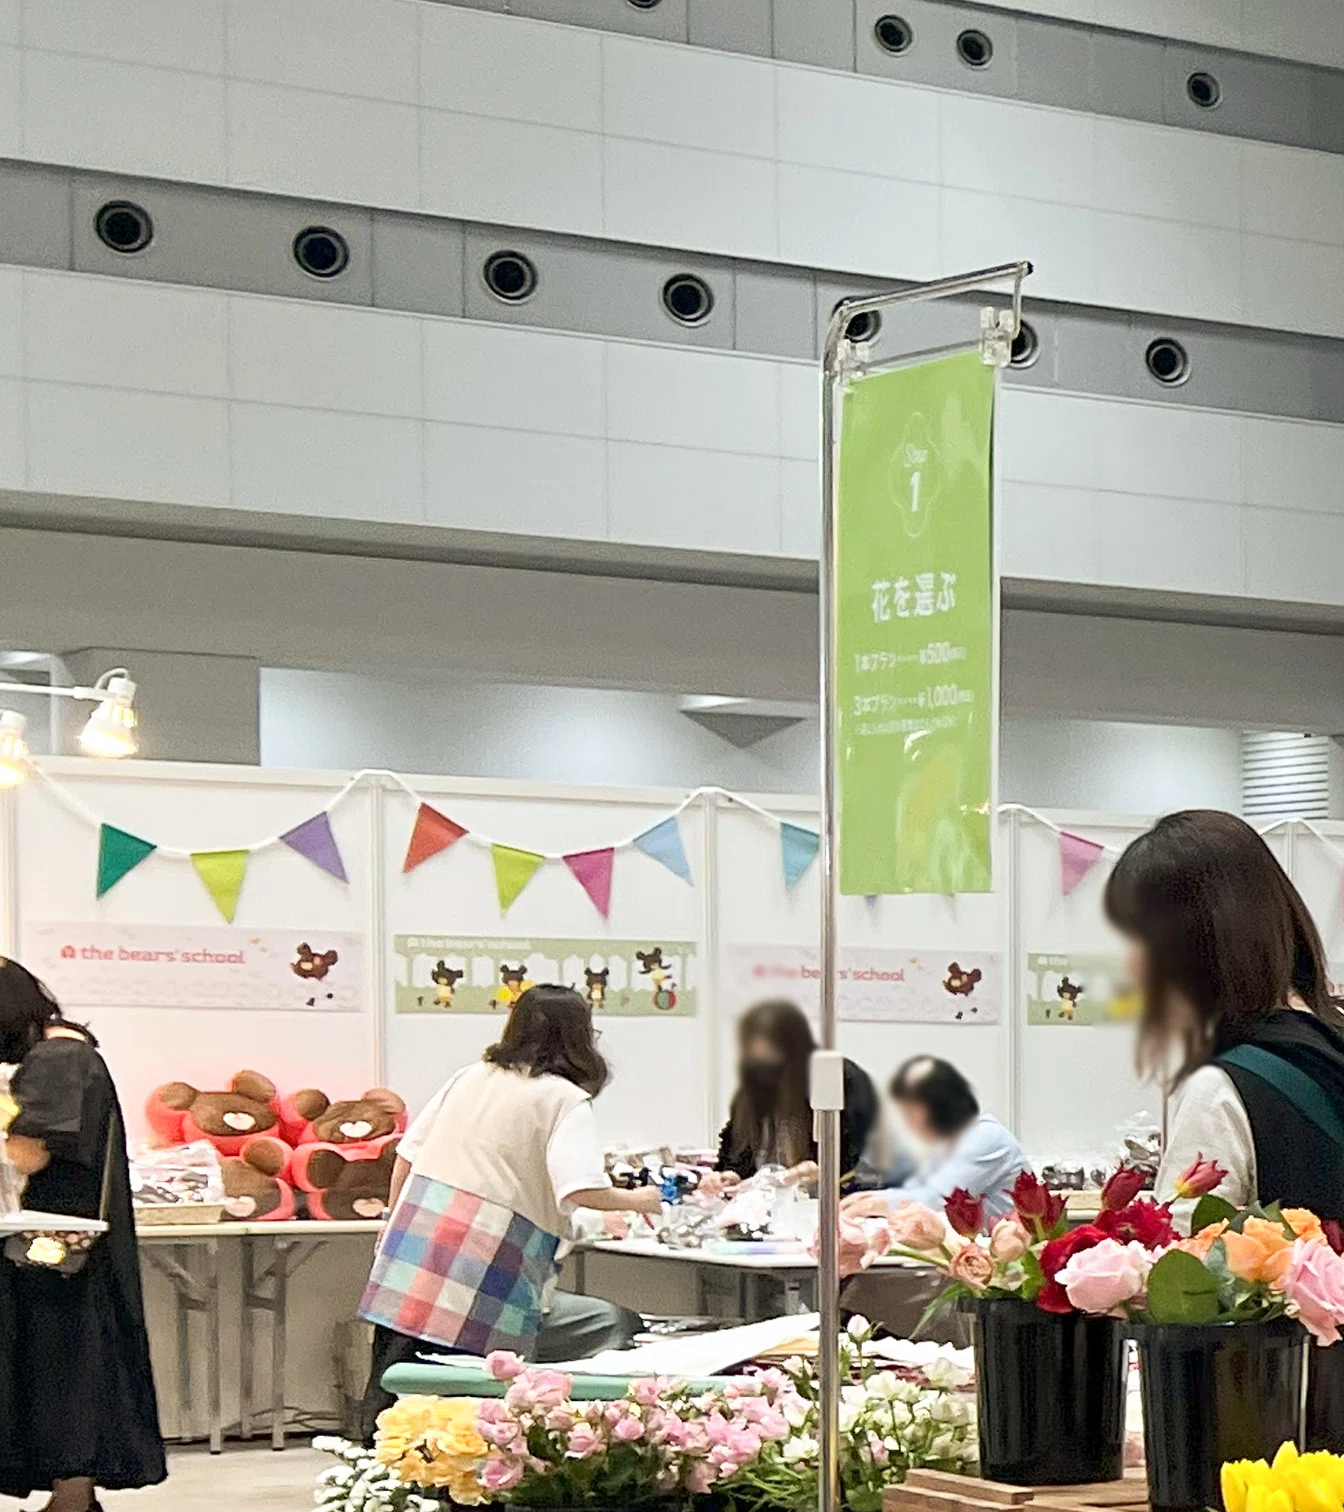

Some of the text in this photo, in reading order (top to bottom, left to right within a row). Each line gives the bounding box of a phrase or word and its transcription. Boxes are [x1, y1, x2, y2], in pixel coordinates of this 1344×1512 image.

[909, 471, 922, 513] 1
[871, 571, 957, 623] 花を選ぶ
[81, 945, 115, 961] the
[181, 947, 246, 965] school
[852, 967, 906, 983] school
